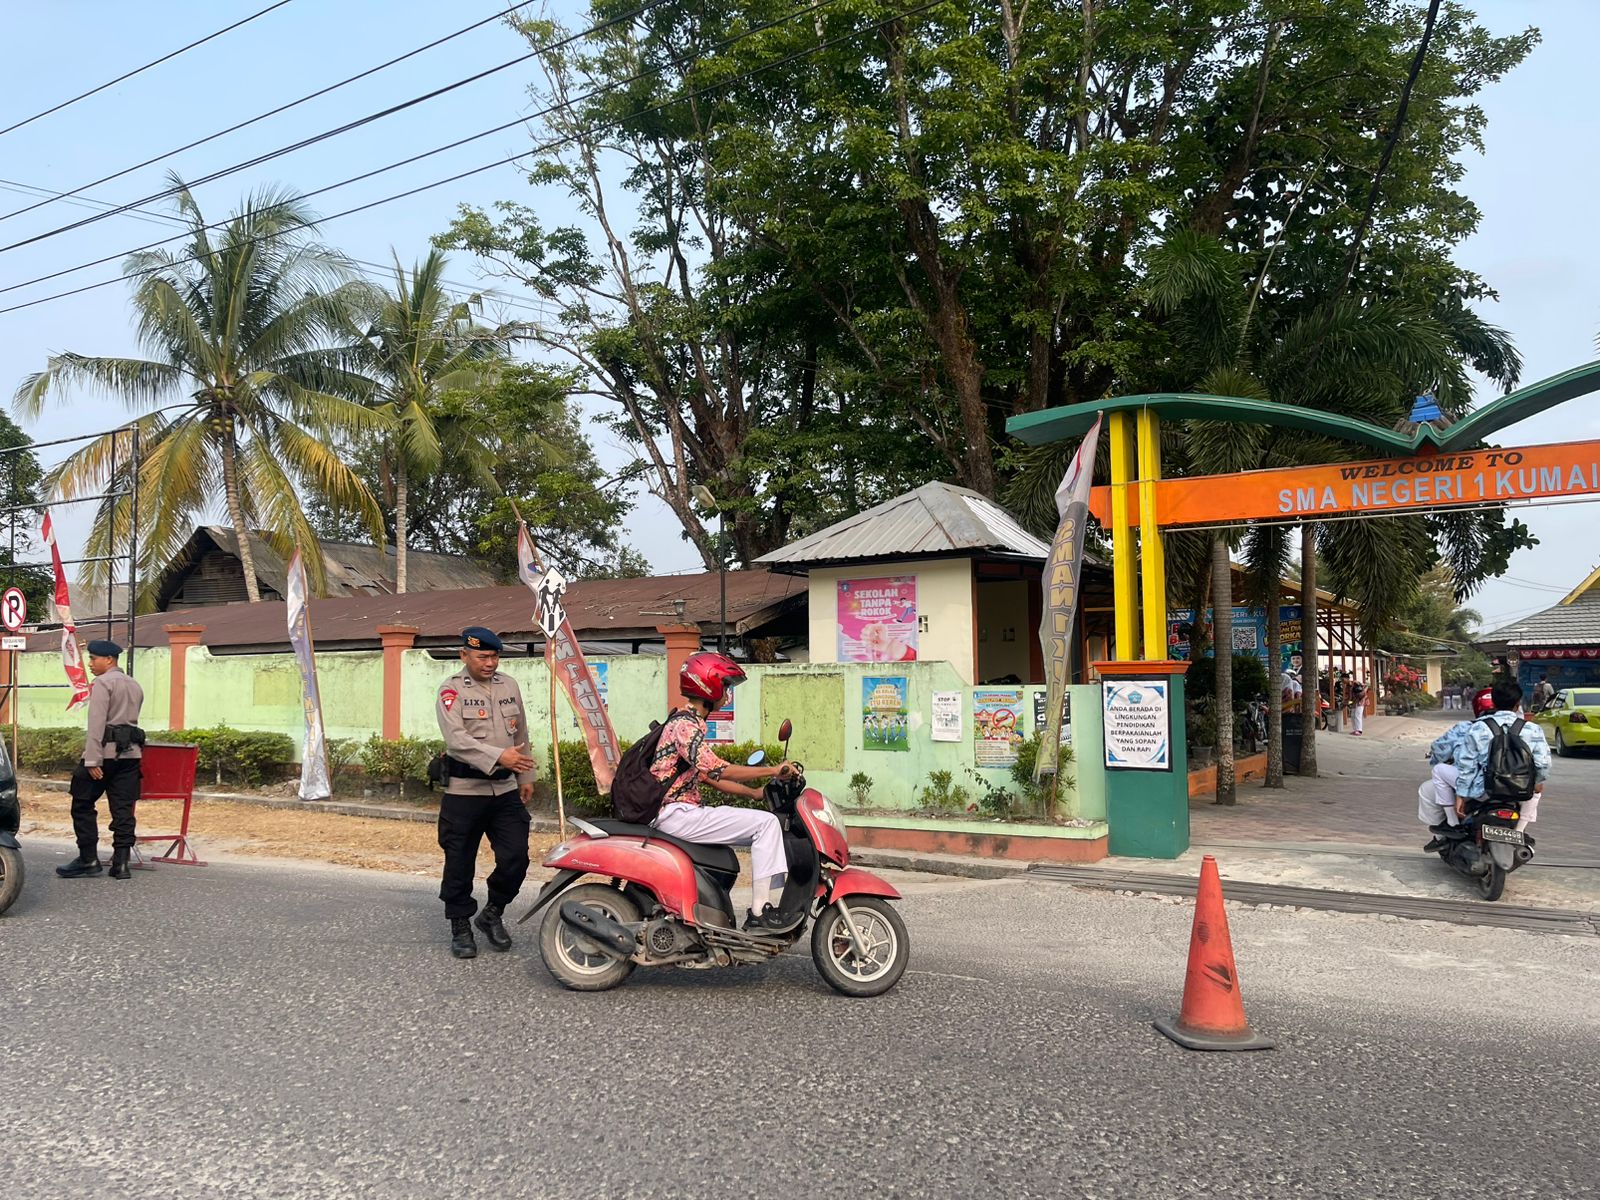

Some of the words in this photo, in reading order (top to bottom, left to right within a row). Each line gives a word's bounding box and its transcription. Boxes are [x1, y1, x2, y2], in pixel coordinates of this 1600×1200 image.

[1339, 456, 1474, 481] WELCOME
[1486, 451, 1523, 468] TO
[1278, 486, 1338, 514] SMA
[1352, 475, 1463, 508] NEGERI
[1473, 478, 1485, 497] 1
[1496, 462, 1599, 496] KUMAI
[854, 588, 898, 599] SEKOLAH
[861, 598, 892, 608] TANPA
[861, 607, 892, 616] ROKOK
